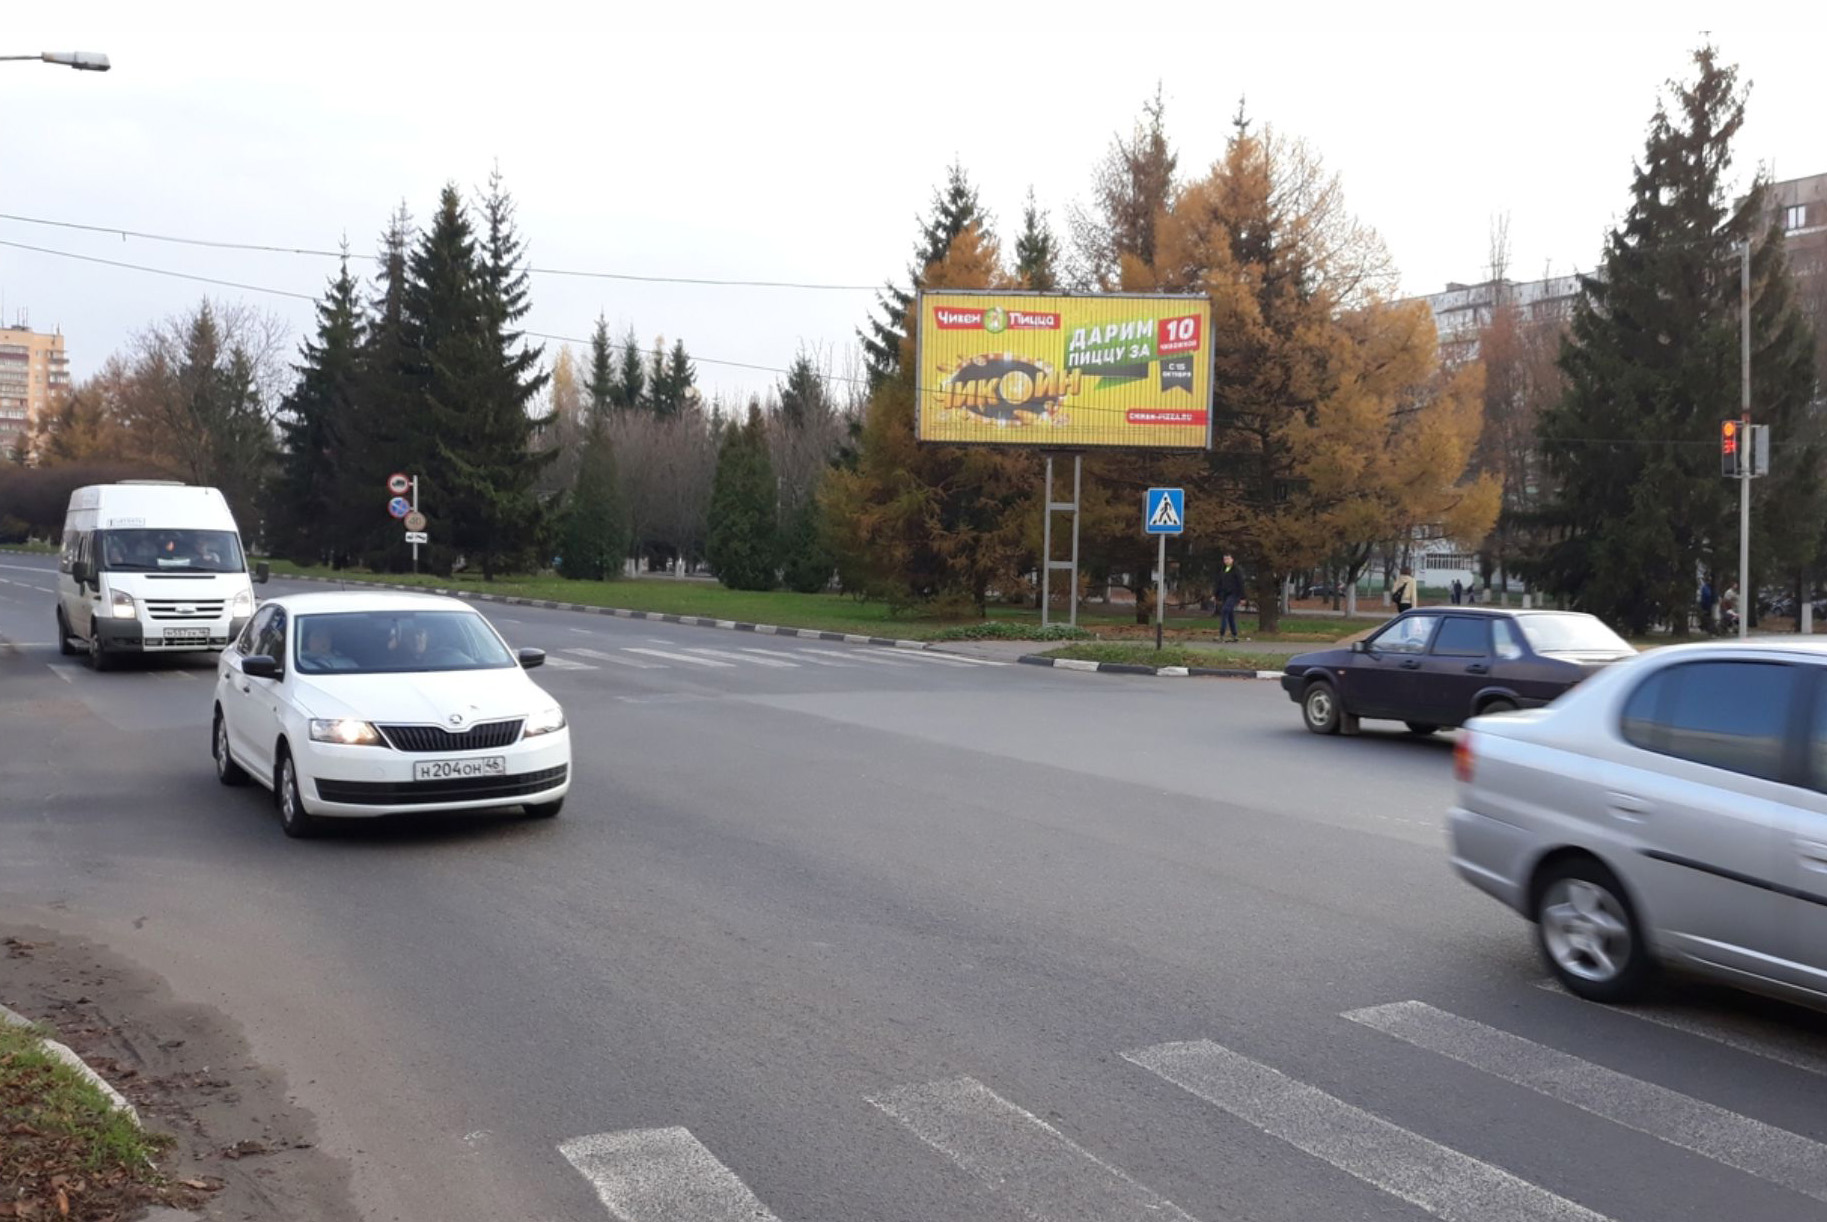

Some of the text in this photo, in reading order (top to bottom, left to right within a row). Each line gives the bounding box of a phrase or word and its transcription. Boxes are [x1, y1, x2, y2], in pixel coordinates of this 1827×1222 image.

[938, 311, 1054, 327] Чикен Пицца
[1166, 317, 1195, 342] 10
[1068, 318, 1154, 352] ДАРИМ
[1068, 343, 1150, 367] ПИЦЦУ ЗА
